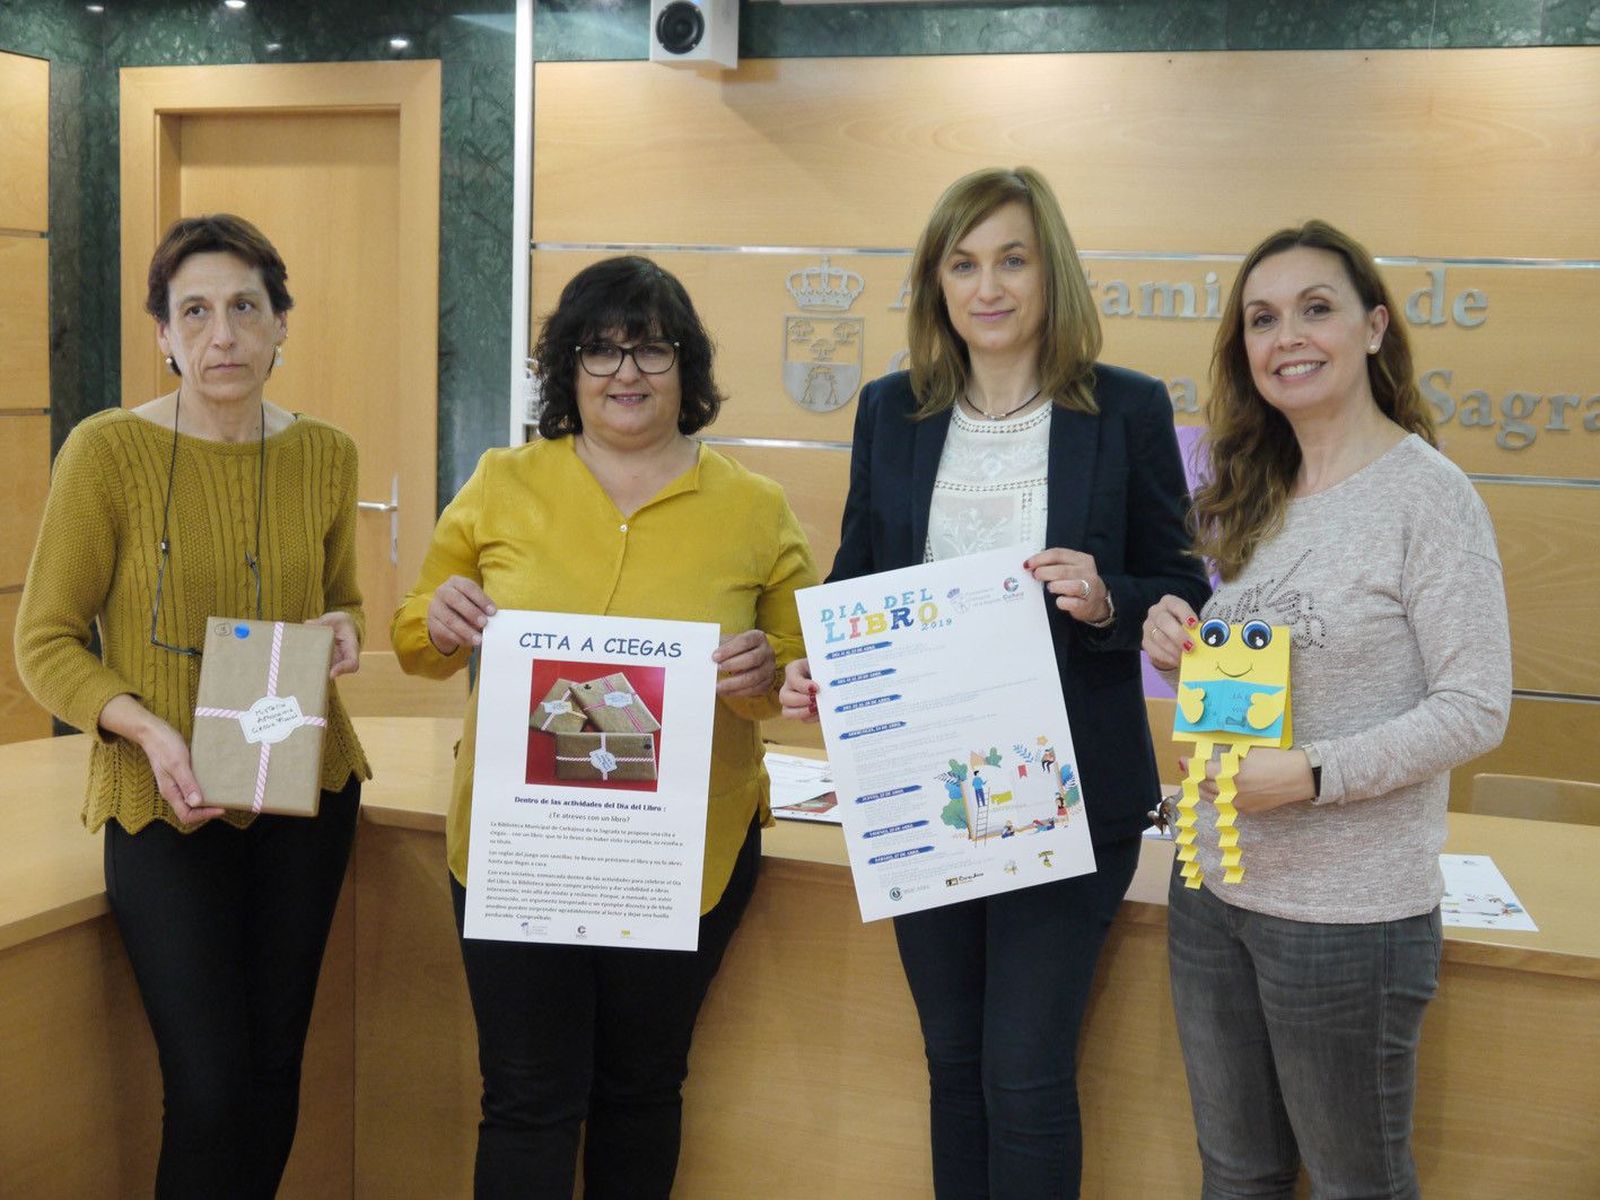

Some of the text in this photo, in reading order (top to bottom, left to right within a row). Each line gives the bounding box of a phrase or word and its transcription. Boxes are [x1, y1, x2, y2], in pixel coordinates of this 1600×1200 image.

[1405, 267, 1488, 327] de
[820, 586, 933, 624] DIA DEL
[825, 602, 939, 644] LIBRO
[920, 617, 953, 632] 2019
[519, 631, 682, 659] CITA A CIEGAS
